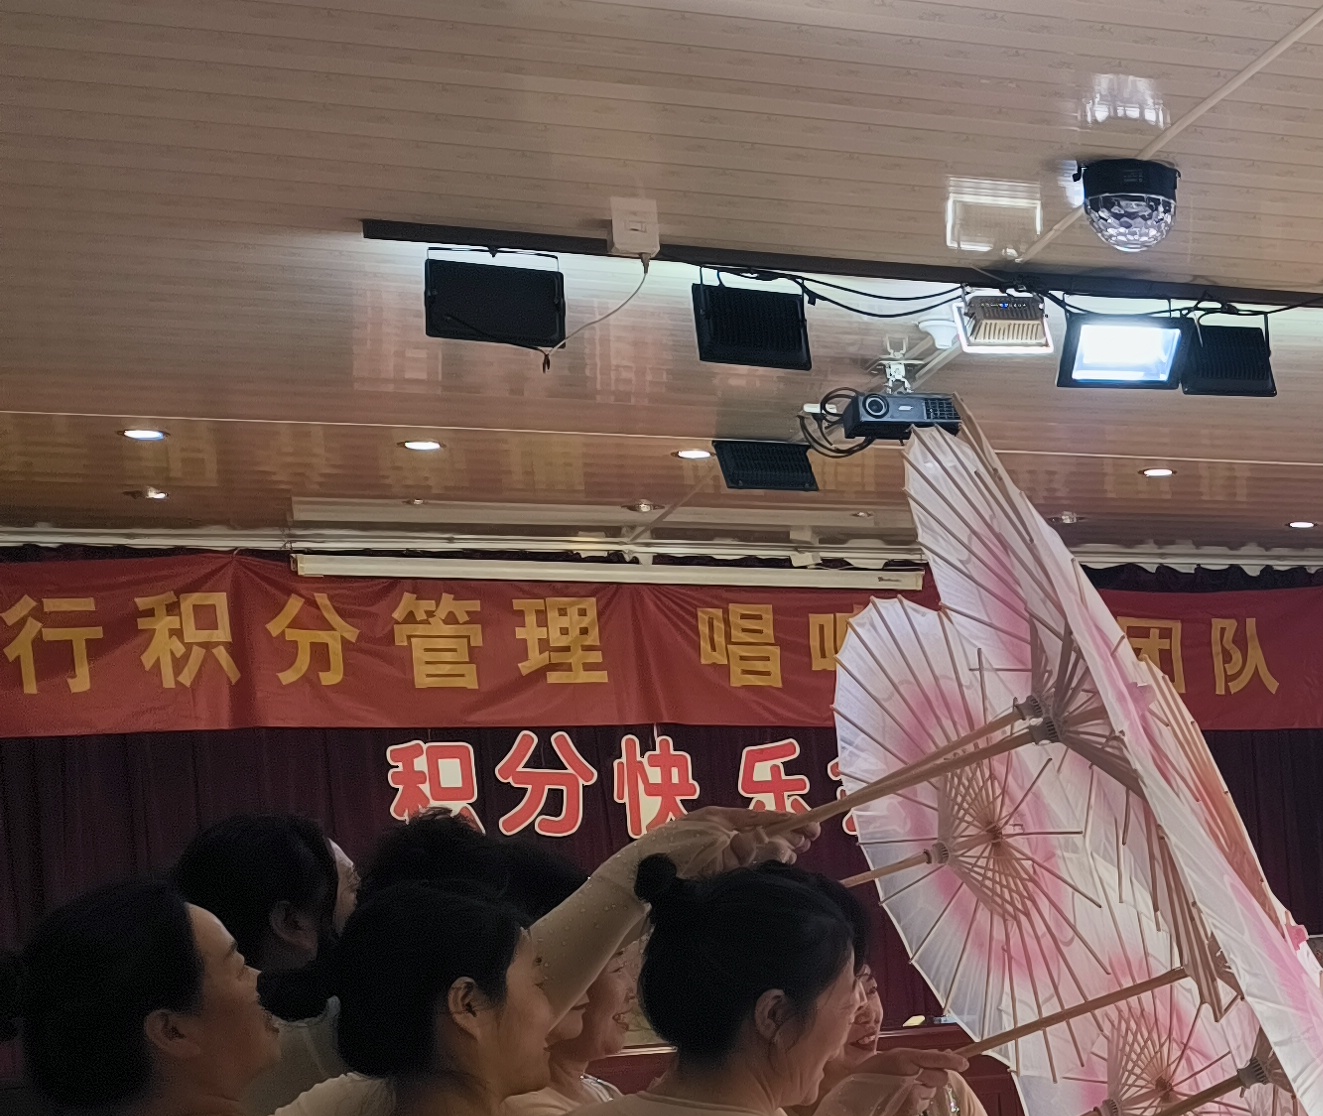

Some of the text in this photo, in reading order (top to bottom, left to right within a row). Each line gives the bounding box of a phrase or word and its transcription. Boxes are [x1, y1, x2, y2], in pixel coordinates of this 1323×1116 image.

[2, 591, 609, 694] 行积分管理
[386, 730, 859, 838] 积分快乐
